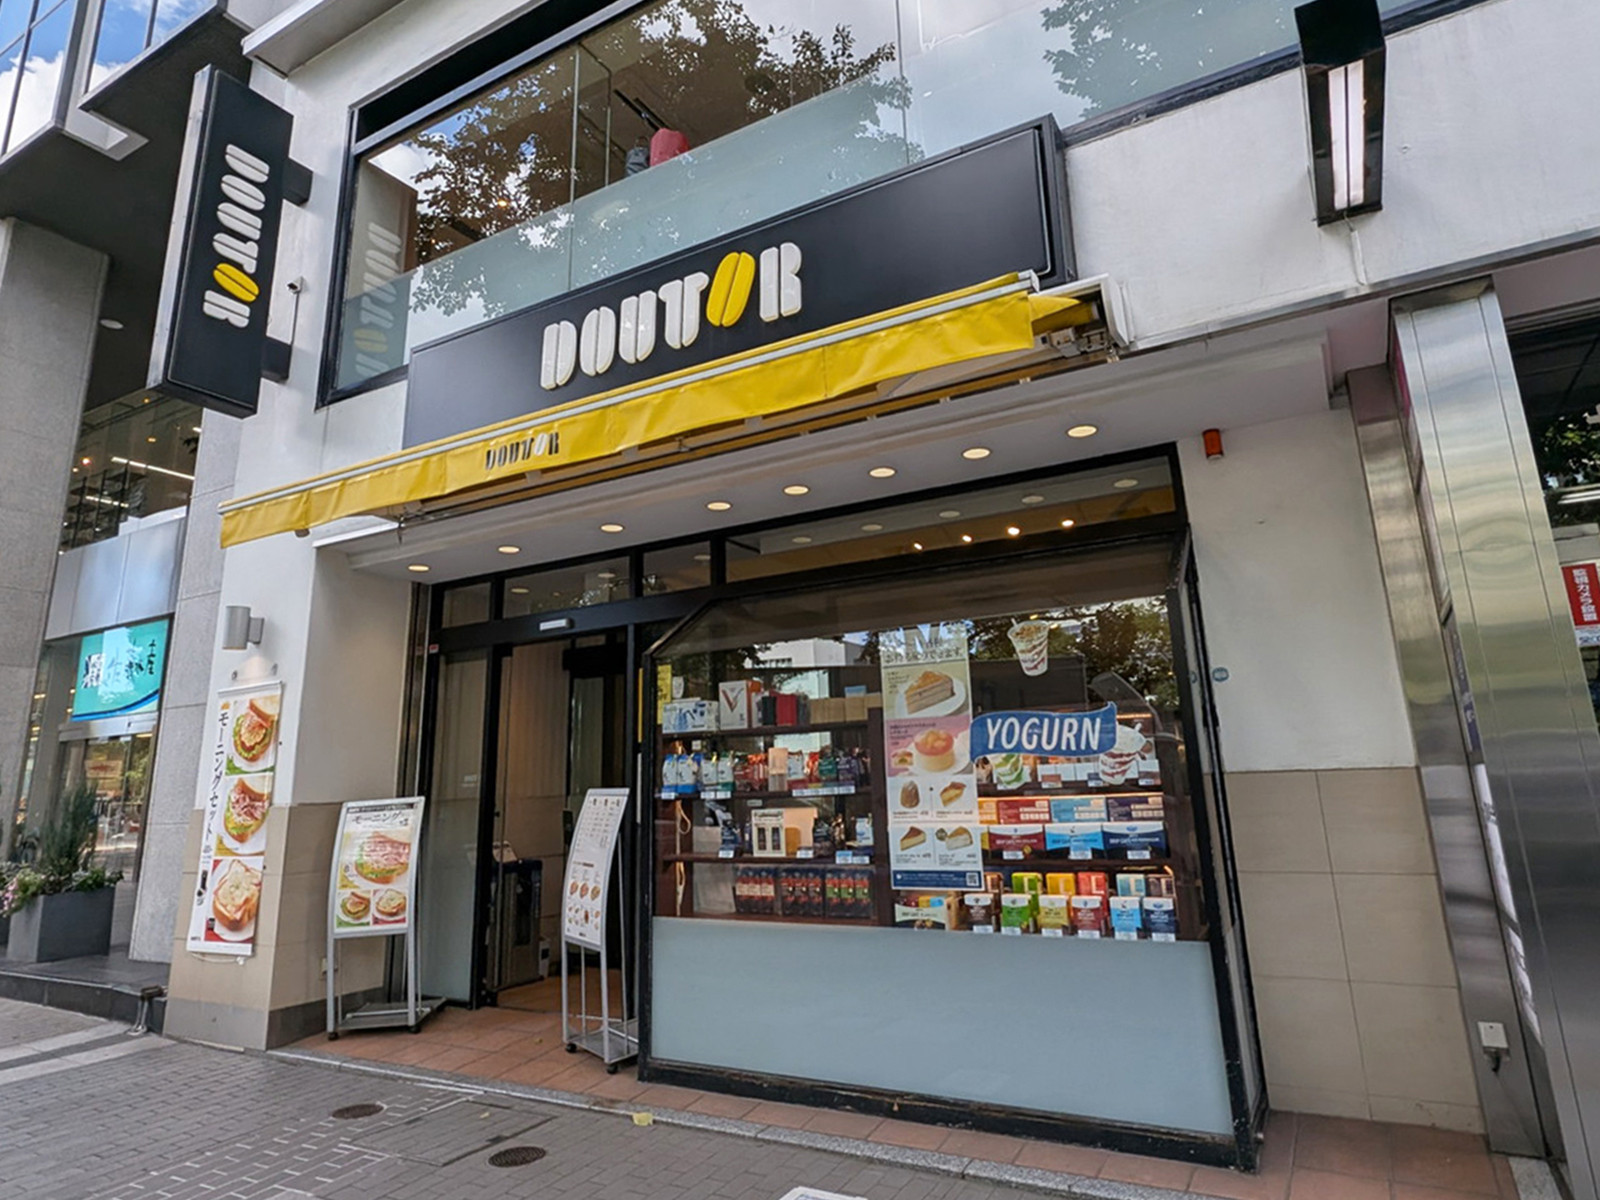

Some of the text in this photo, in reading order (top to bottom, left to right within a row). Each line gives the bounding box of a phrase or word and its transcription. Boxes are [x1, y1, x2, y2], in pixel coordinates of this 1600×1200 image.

[203, 144, 270, 328] DOUTOR
[540, 242, 802, 390] DOUTOR
[485, 432, 560, 470] DOUTOR
[986, 717, 1101, 751] YOGURN
[206, 712, 229, 841] モーニングセット
[352, 811, 402, 825] モーニング
